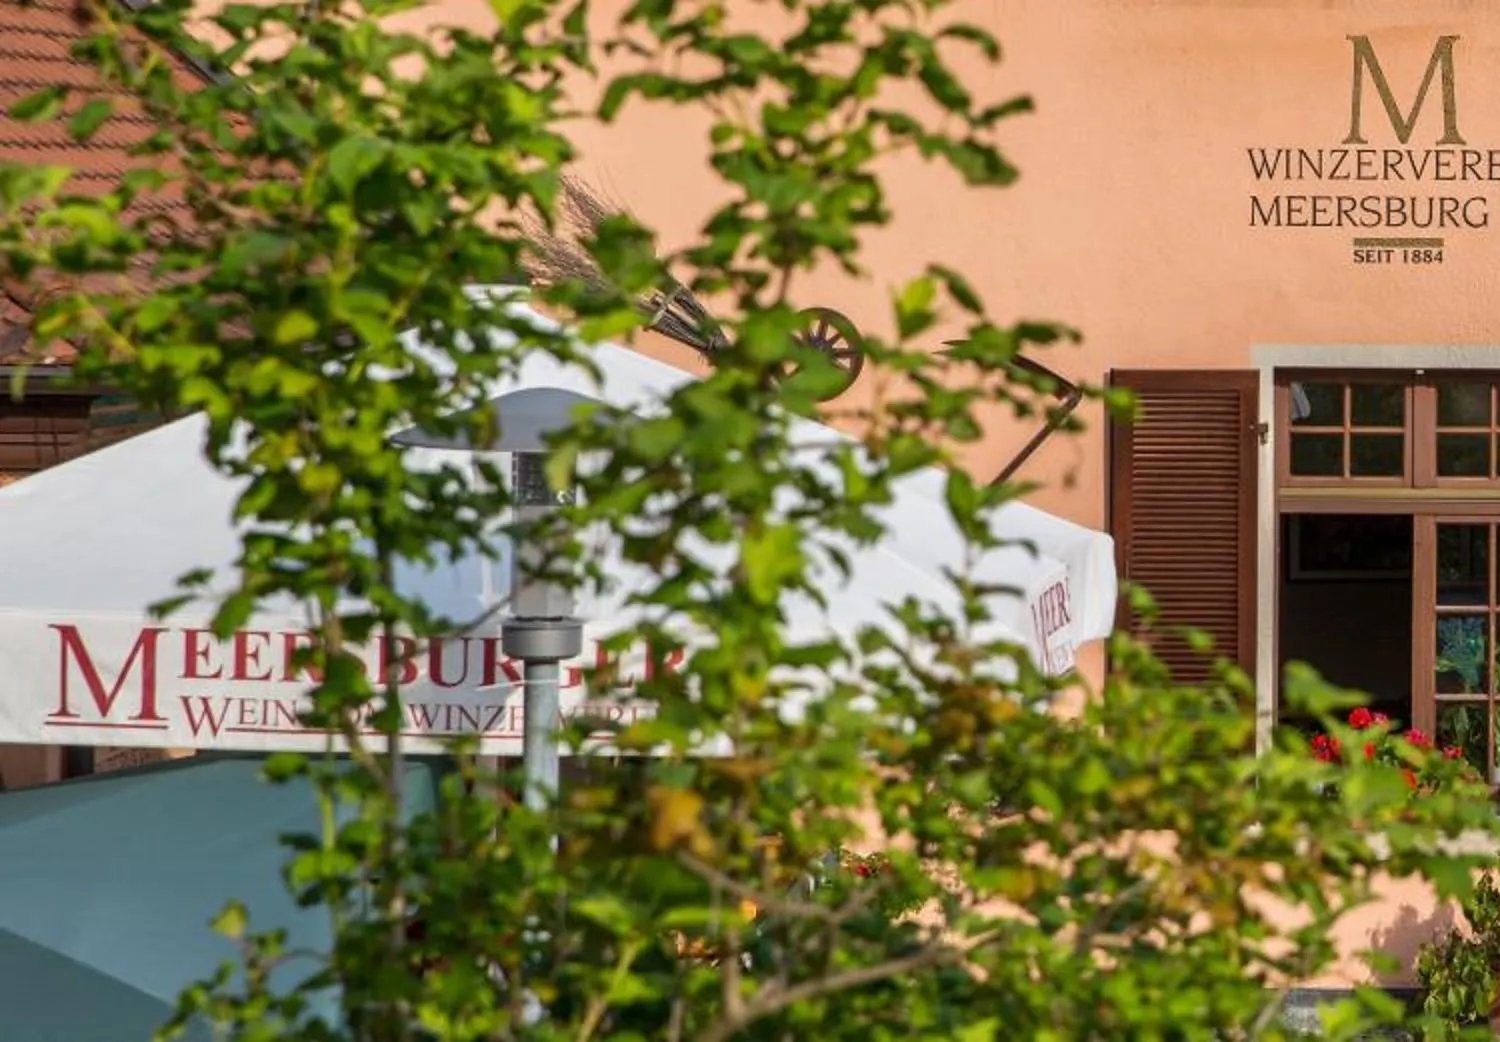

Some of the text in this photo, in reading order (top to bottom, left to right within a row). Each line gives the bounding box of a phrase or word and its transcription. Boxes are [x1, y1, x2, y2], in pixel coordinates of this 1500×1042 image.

[1341, 34, 1467, 145] M
[1248, 195, 1489, 229] MEERSBURG
[1353, 248, 1444, 265] SEIT 1884
[47, 623, 690, 722] MEERBUR
